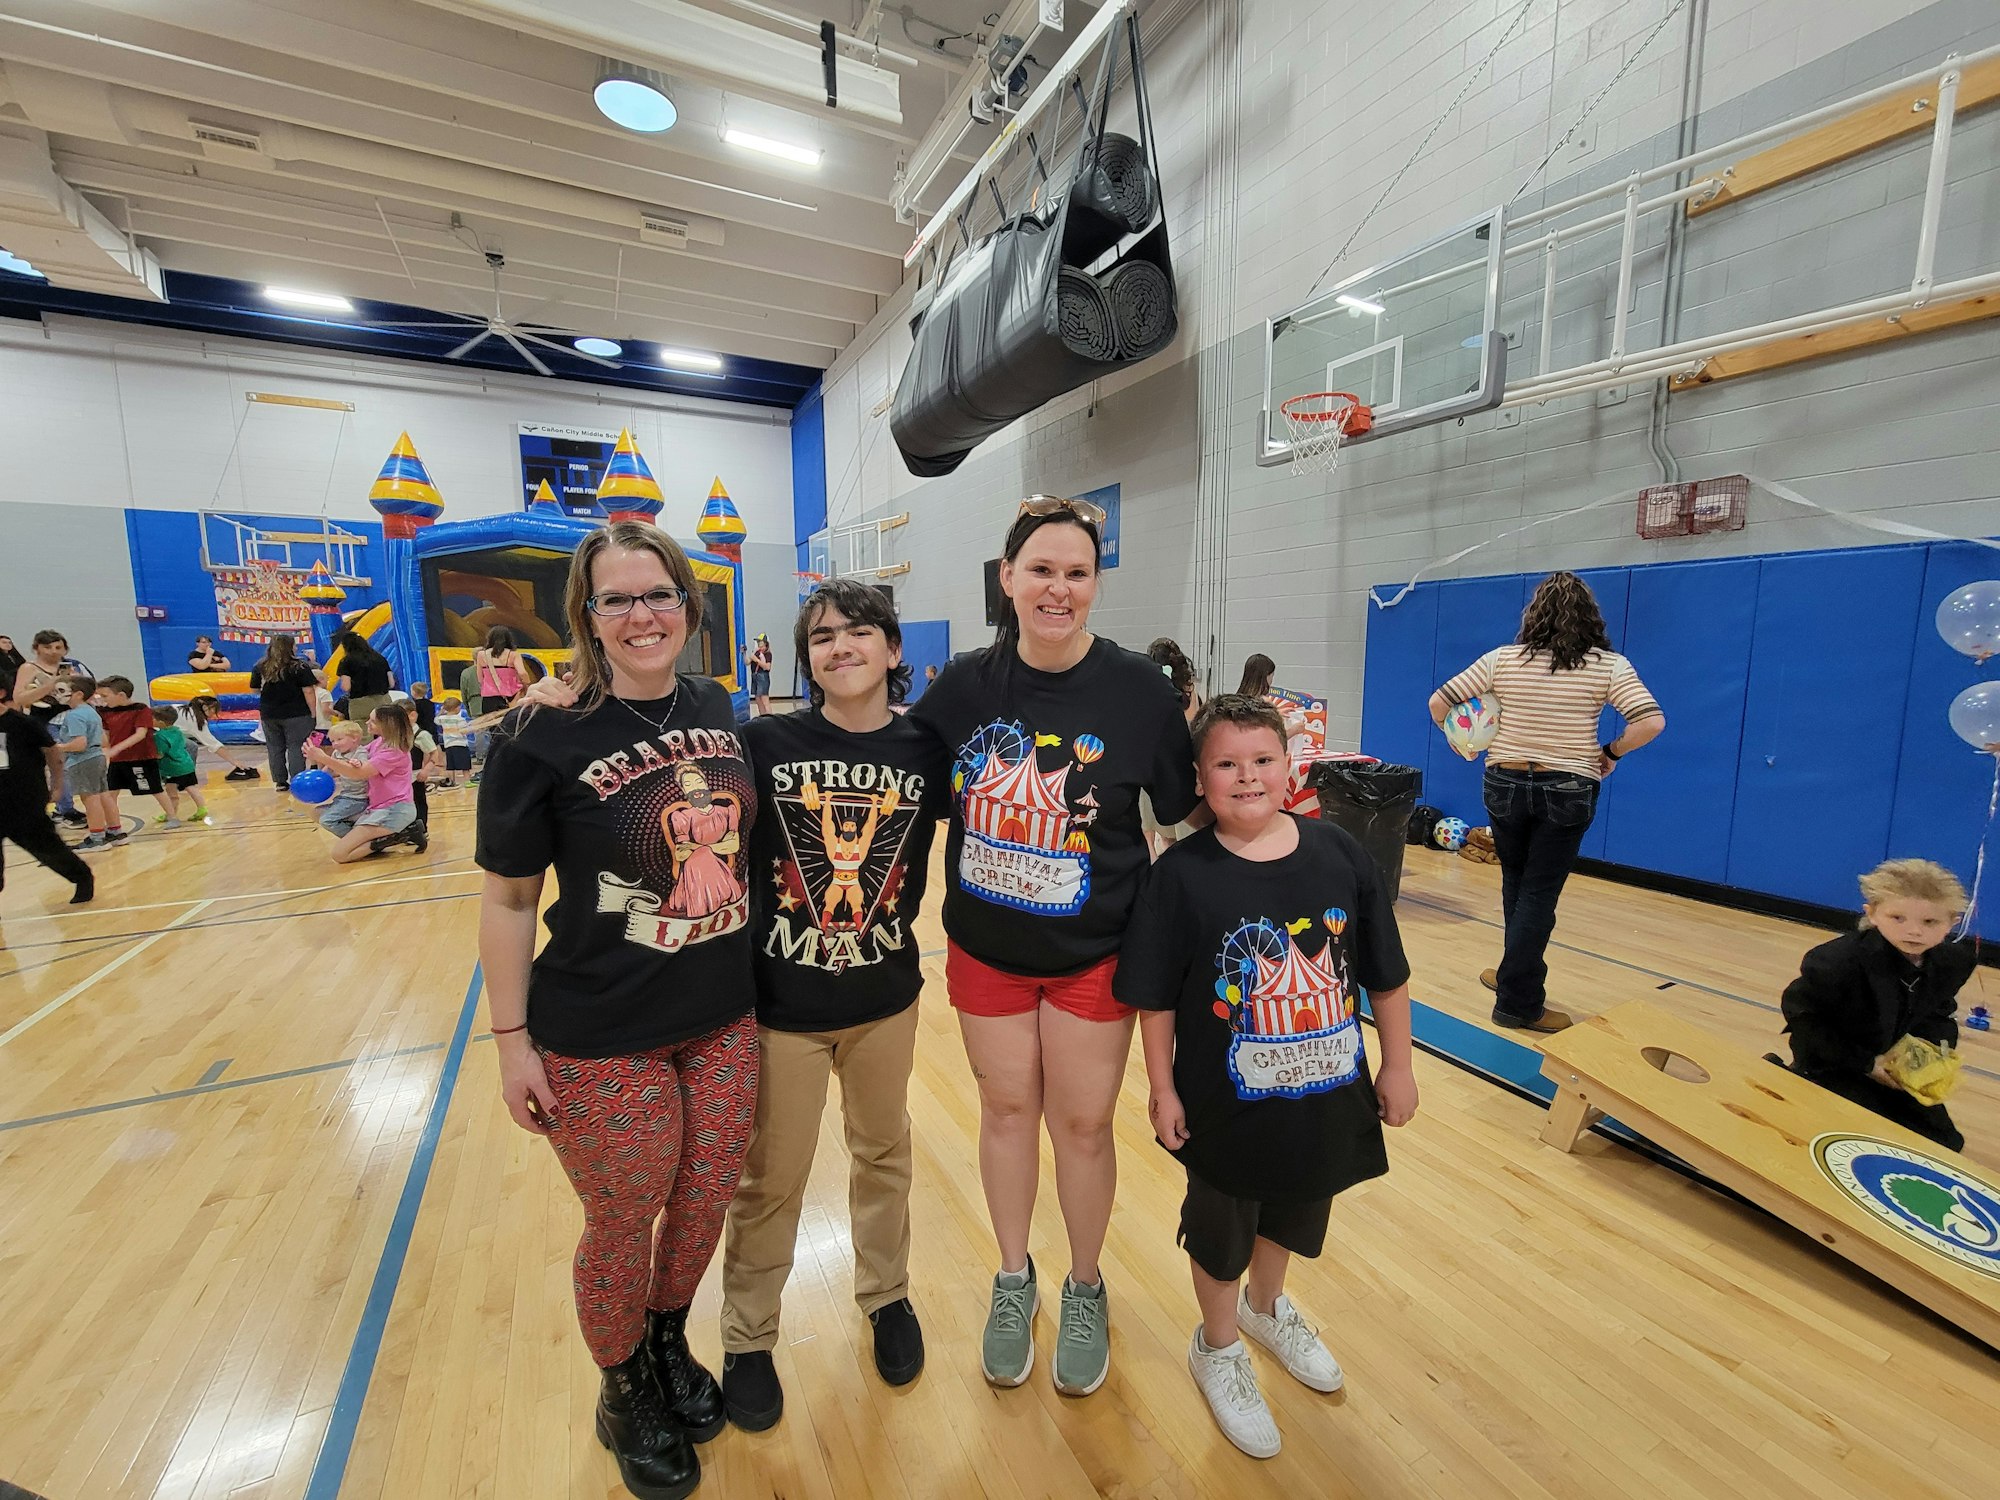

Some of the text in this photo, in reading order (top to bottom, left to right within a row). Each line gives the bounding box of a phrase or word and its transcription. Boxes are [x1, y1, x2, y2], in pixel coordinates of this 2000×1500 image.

[565, 428, 580, 437] City
[581, 430, 604, 438] Middle
[568, 463, 589, 472] PERIOD
[525, 483, 540, 491] FOU
[563, 485, 598, 495] PLAYER FOU
[572, 507, 592, 516] MATCH
[234, 603, 310, 622] CARNIVA
[771, 759, 925, 802] STRONG
[971, 866, 1045, 899] CREW
[763, 914, 906, 972] MAN
[1252, 1037, 1350, 1069] CARNIVAL
[1275, 1060, 1341, 1084] CREW
[1831, 1142, 1865, 1159] CITY
